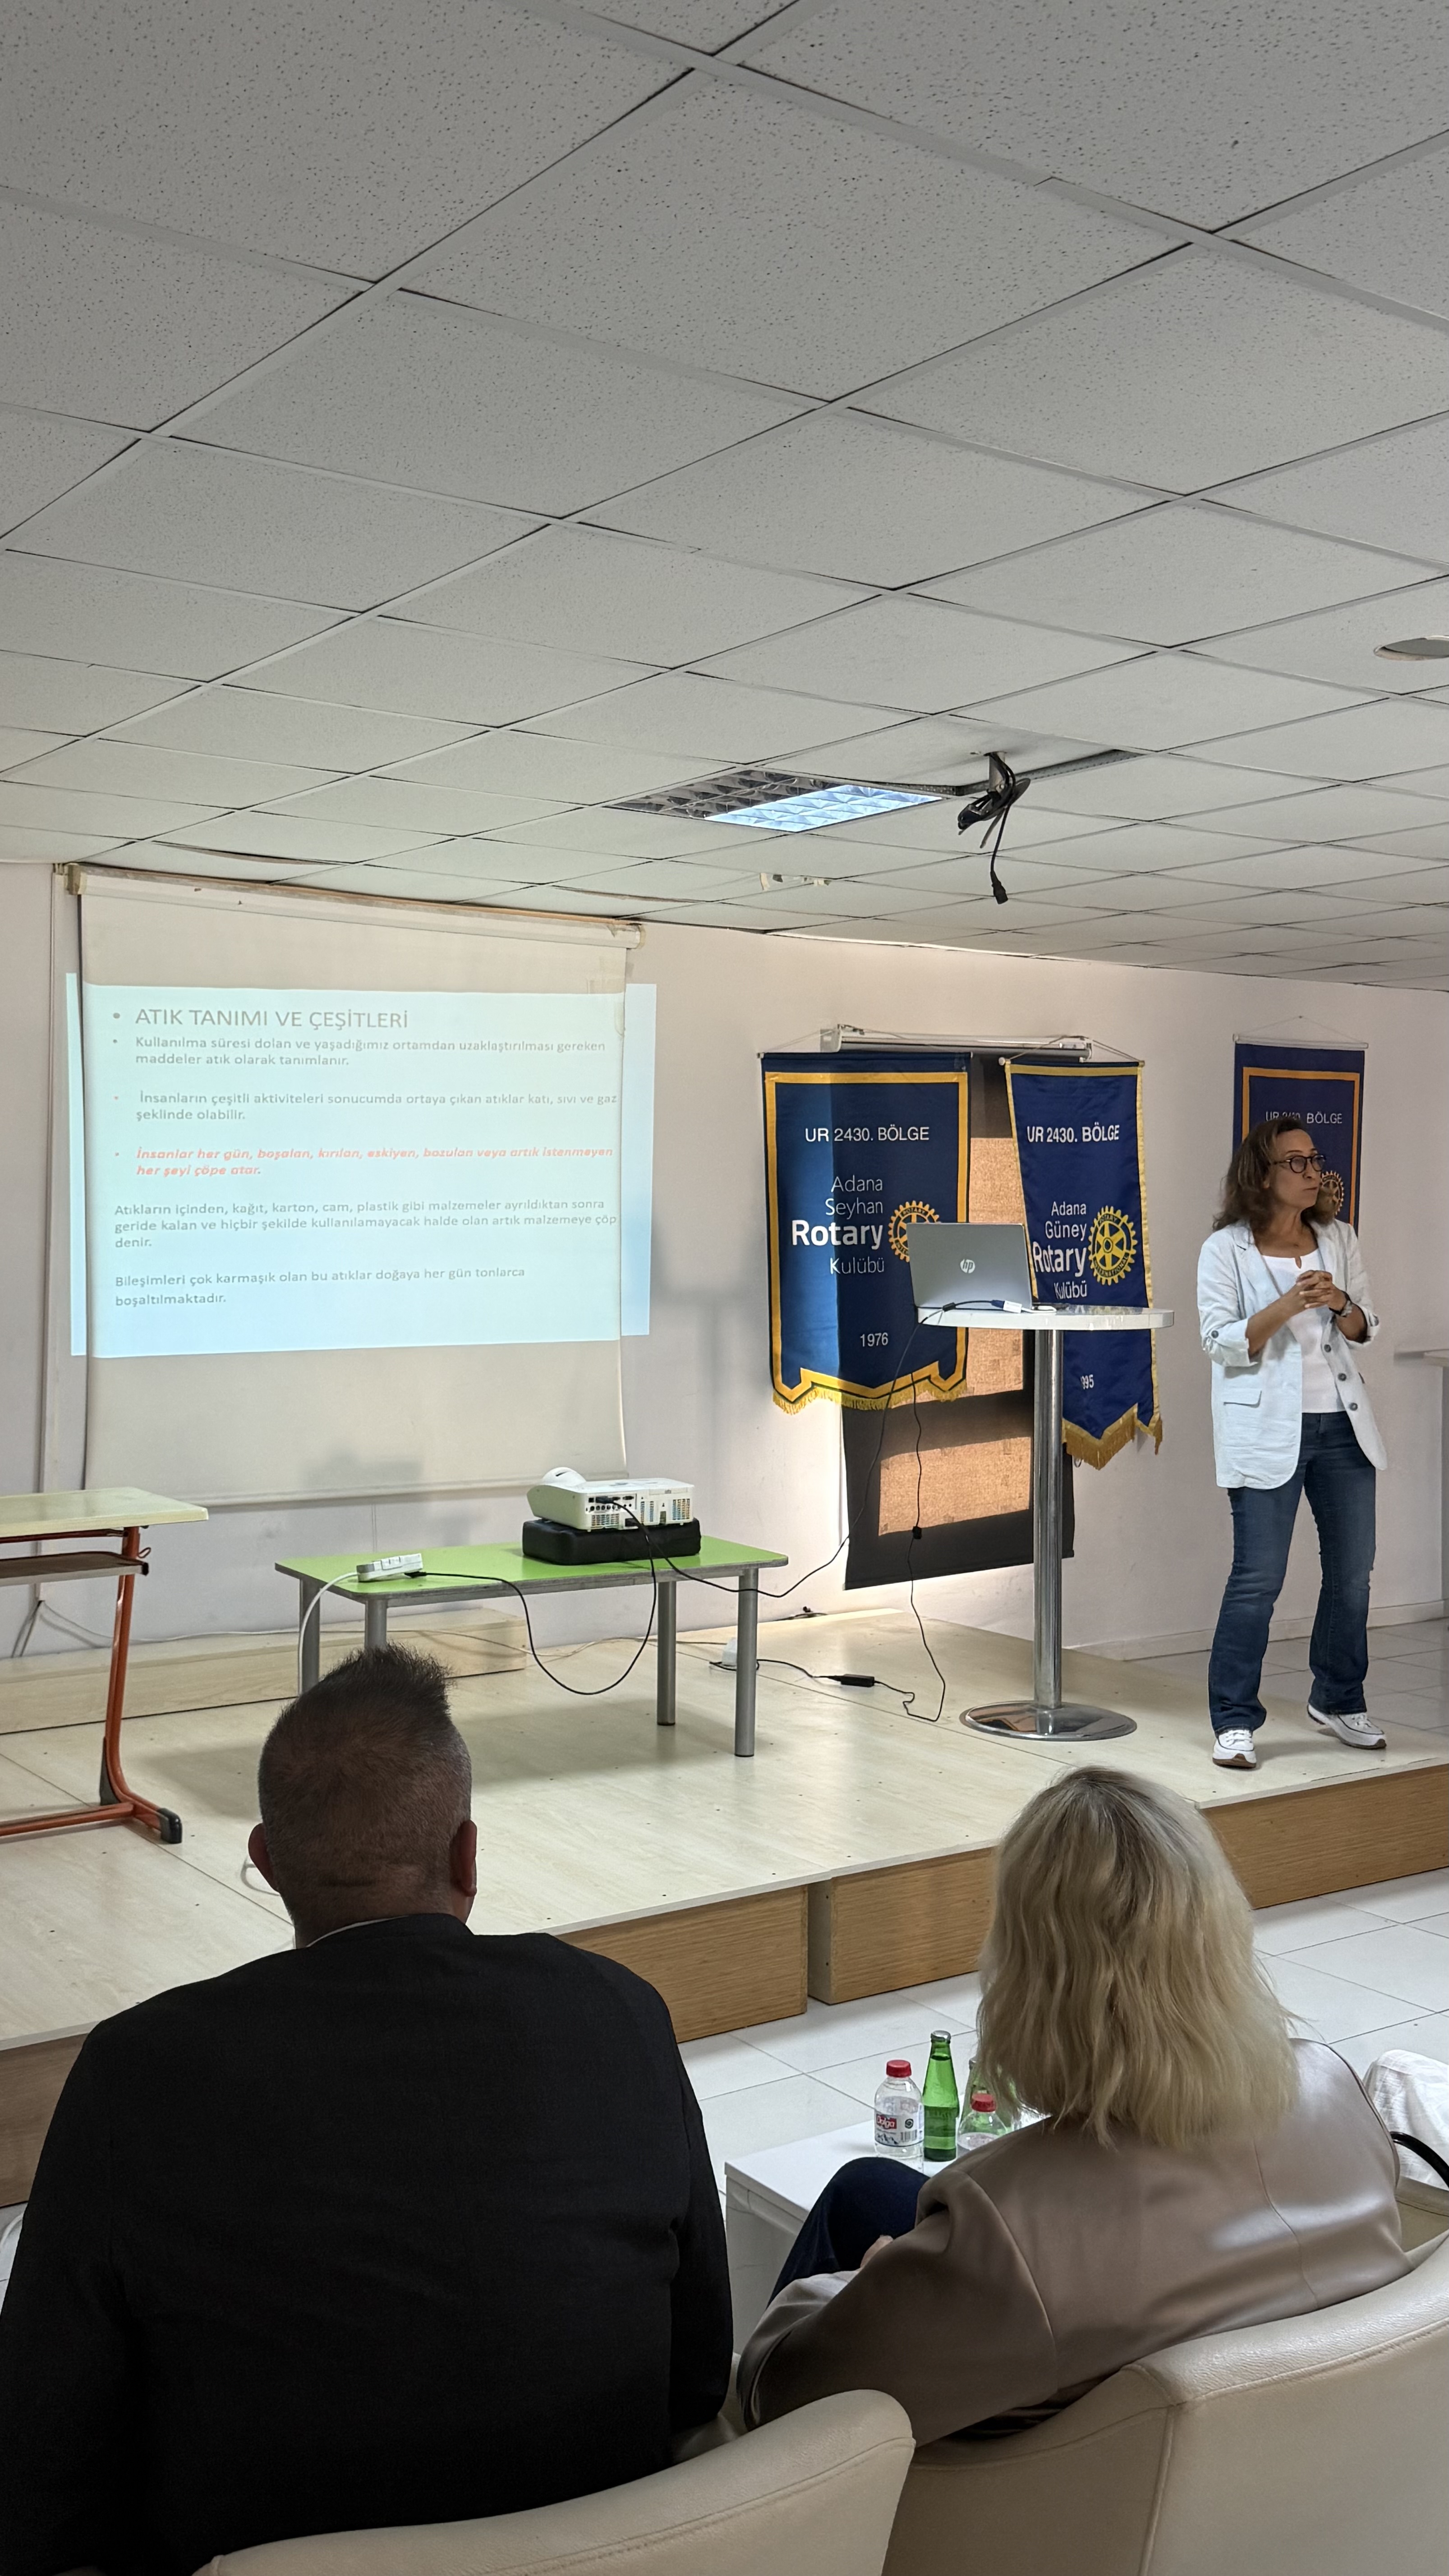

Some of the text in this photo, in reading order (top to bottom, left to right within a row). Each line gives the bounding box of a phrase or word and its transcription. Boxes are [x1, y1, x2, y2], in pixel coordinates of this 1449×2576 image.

[135, 1009, 407, 1030] ATIK TANIMI VE ÇEŞİTLERİ
[136, 1036, 207, 1048] Kullanılma
[211, 1038, 250, 1048] süresi
[255, 1038, 291, 1049] dolan
[314, 1039, 388, 1051] yaşadığımız
[393, 1041, 455, 1050] ortamdan
[460, 1040, 553, 1053] uzaklaştırılması
[557, 1041, 605, 1053] gereken
[136, 1053, 349, 1065] maddeler atık olarak tanımlanır.
[141, 1090, 207, 1103] İnsanların
[212, 1093, 249, 1106] çeşitli
[254, 1093, 323, 1104] aktiviteleri
[406, 1095, 445, 1105] ortaya
[450, 1094, 481, 1105] çıkan
[486, 1094, 524, 1104] atıklar
[529, 1094, 553, 1104] katı,
[598, 1095, 617, 1105] gaz
[137, 1109, 245, 1122] şeklinde olabilir.
[1306, 1111, 1342, 1124] BÖLGE
[805, 1124, 929, 1142] UR 2430. BÖLGE
[1027, 1122, 1120, 1142] UR 2430. BÖLGE
[137, 1146, 194, 1159] İnsanlar
[197, 1149, 220, 1159] her
[478, 1150, 506, 1159] veya
[511, 1147, 539, 1156] artık
[137, 1165, 161, 1175] her
[831, 1175, 883, 1192] Adana
[115, 1204, 171, 1215] Atıkların
[176, 1203, 228, 1216] içinden,
[233, 1203, 267, 1215] kağıt,
[273, 1203, 318, 1214] karton,
[322, 1205, 353, 1213] cam,
[357, 1201, 398, 1213] plastik
[402, 1201, 424, 1213] gibi
[429, 1200, 501, 1210] malzemeler
[505, 1199, 568, 1211] ayrıldıktan
[825, 1197, 883, 1219] Seyhan
[1051, 1201, 1086, 1216] Adana
[115, 1220, 156, 1234] geride
[161, 1220, 197, 1230] kalan
[221, 1219, 258, 1231] hiçbir
[262, 1218, 307, 1231] şekilde
[312, 1216, 419, 1228] kullanılamayacak
[424, 1216, 458, 1225] halde
[462, 1215, 488, 1225] olan
[492, 1215, 520, 1225] artık
[524, 1215, 592, 1225] malzemeye
[595, 1215, 616, 1226] çöp
[1045, 1220, 1087, 1241] Güney
[115, 1237, 152, 1247] denir.
[792, 1220, 883, 1250] Rotary
[830, 1256, 884, 1274] Kulübü
[961, 1259, 975, 1273] hp
[1033, 1241, 1087, 1277] Rotary
[116, 1267, 524, 1288] Bileşimleri çok karmaşık olan bu atıklar doğaya her gün tonlarca
[116, 1293, 225, 1307] boşaltılmaktadır.
[860, 1332, 888, 1347] 1976
